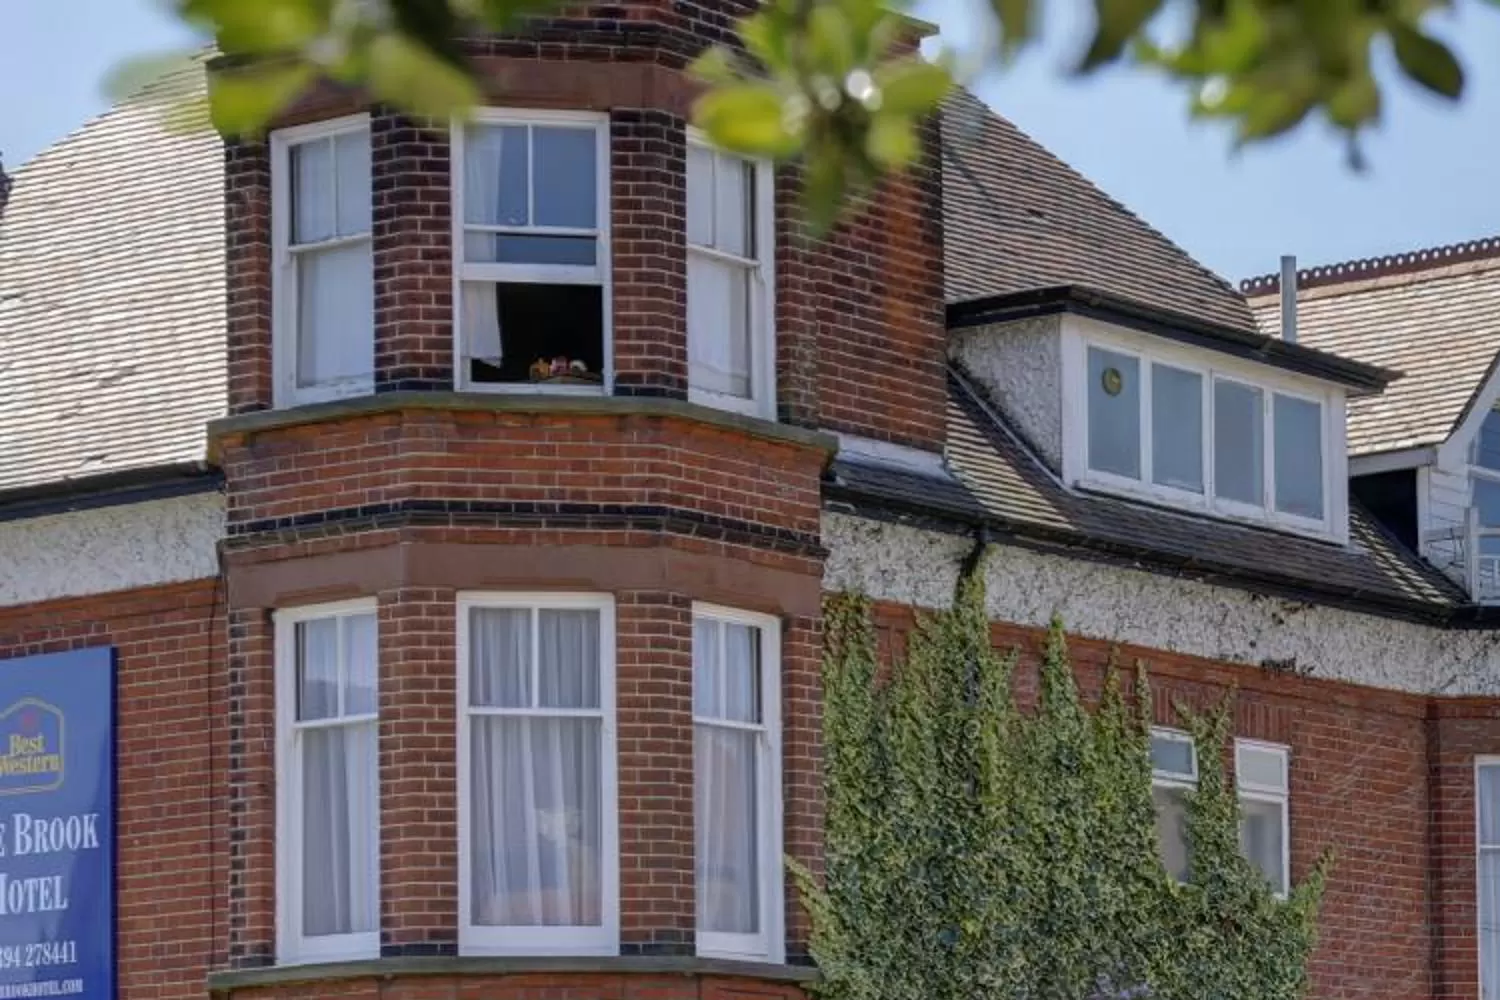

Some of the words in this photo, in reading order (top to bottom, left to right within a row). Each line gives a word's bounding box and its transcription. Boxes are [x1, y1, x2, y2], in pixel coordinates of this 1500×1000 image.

[10, 731, 46, 757] Best
[12, 812, 100, 856] BROOK
[25, 940, 77, 967] 278441
